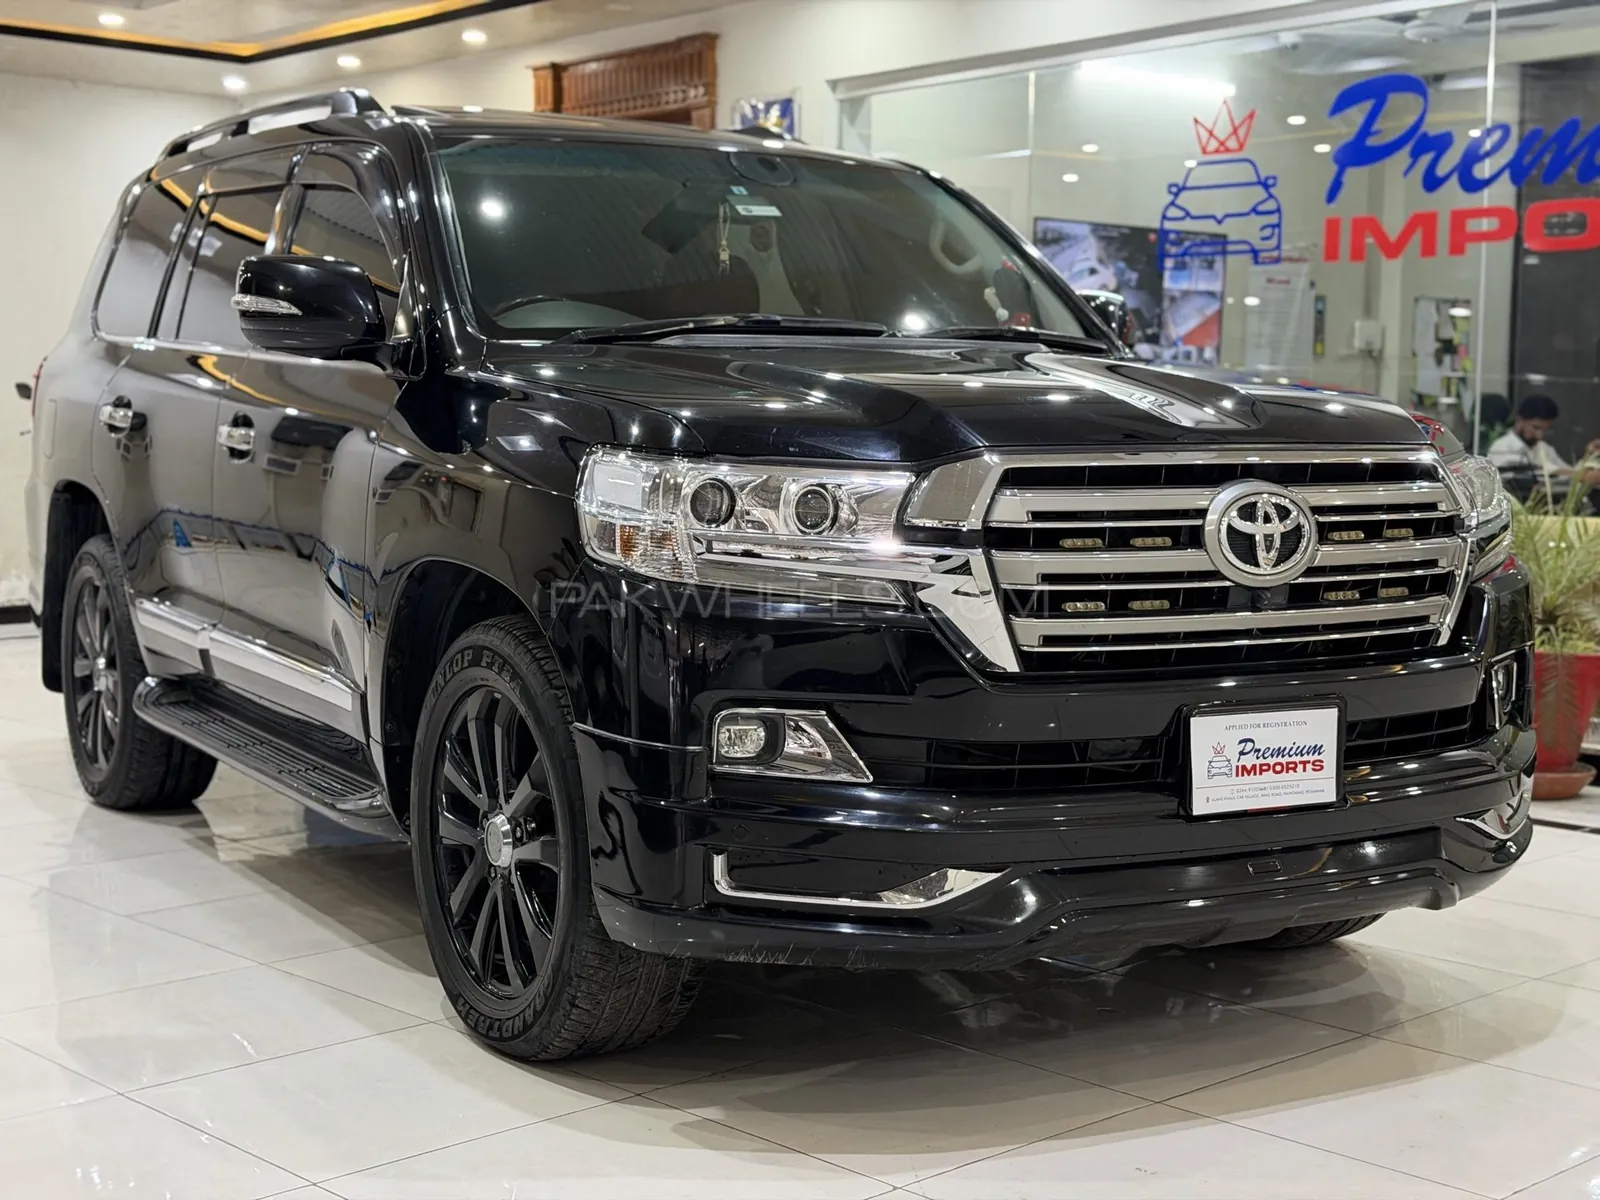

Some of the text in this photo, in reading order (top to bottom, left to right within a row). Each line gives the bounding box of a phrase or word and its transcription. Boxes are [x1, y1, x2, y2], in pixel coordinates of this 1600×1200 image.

[1325, 73, 1600, 206] Prem
[1323, 197, 1600, 262] IMPO
[1224, 723, 1248, 731] APPLIED
[1262, 720, 1307, 729] REGISTRATION
[1237, 737, 1325, 763] Premium
[1235, 759, 1325, 778] IMPORTS
